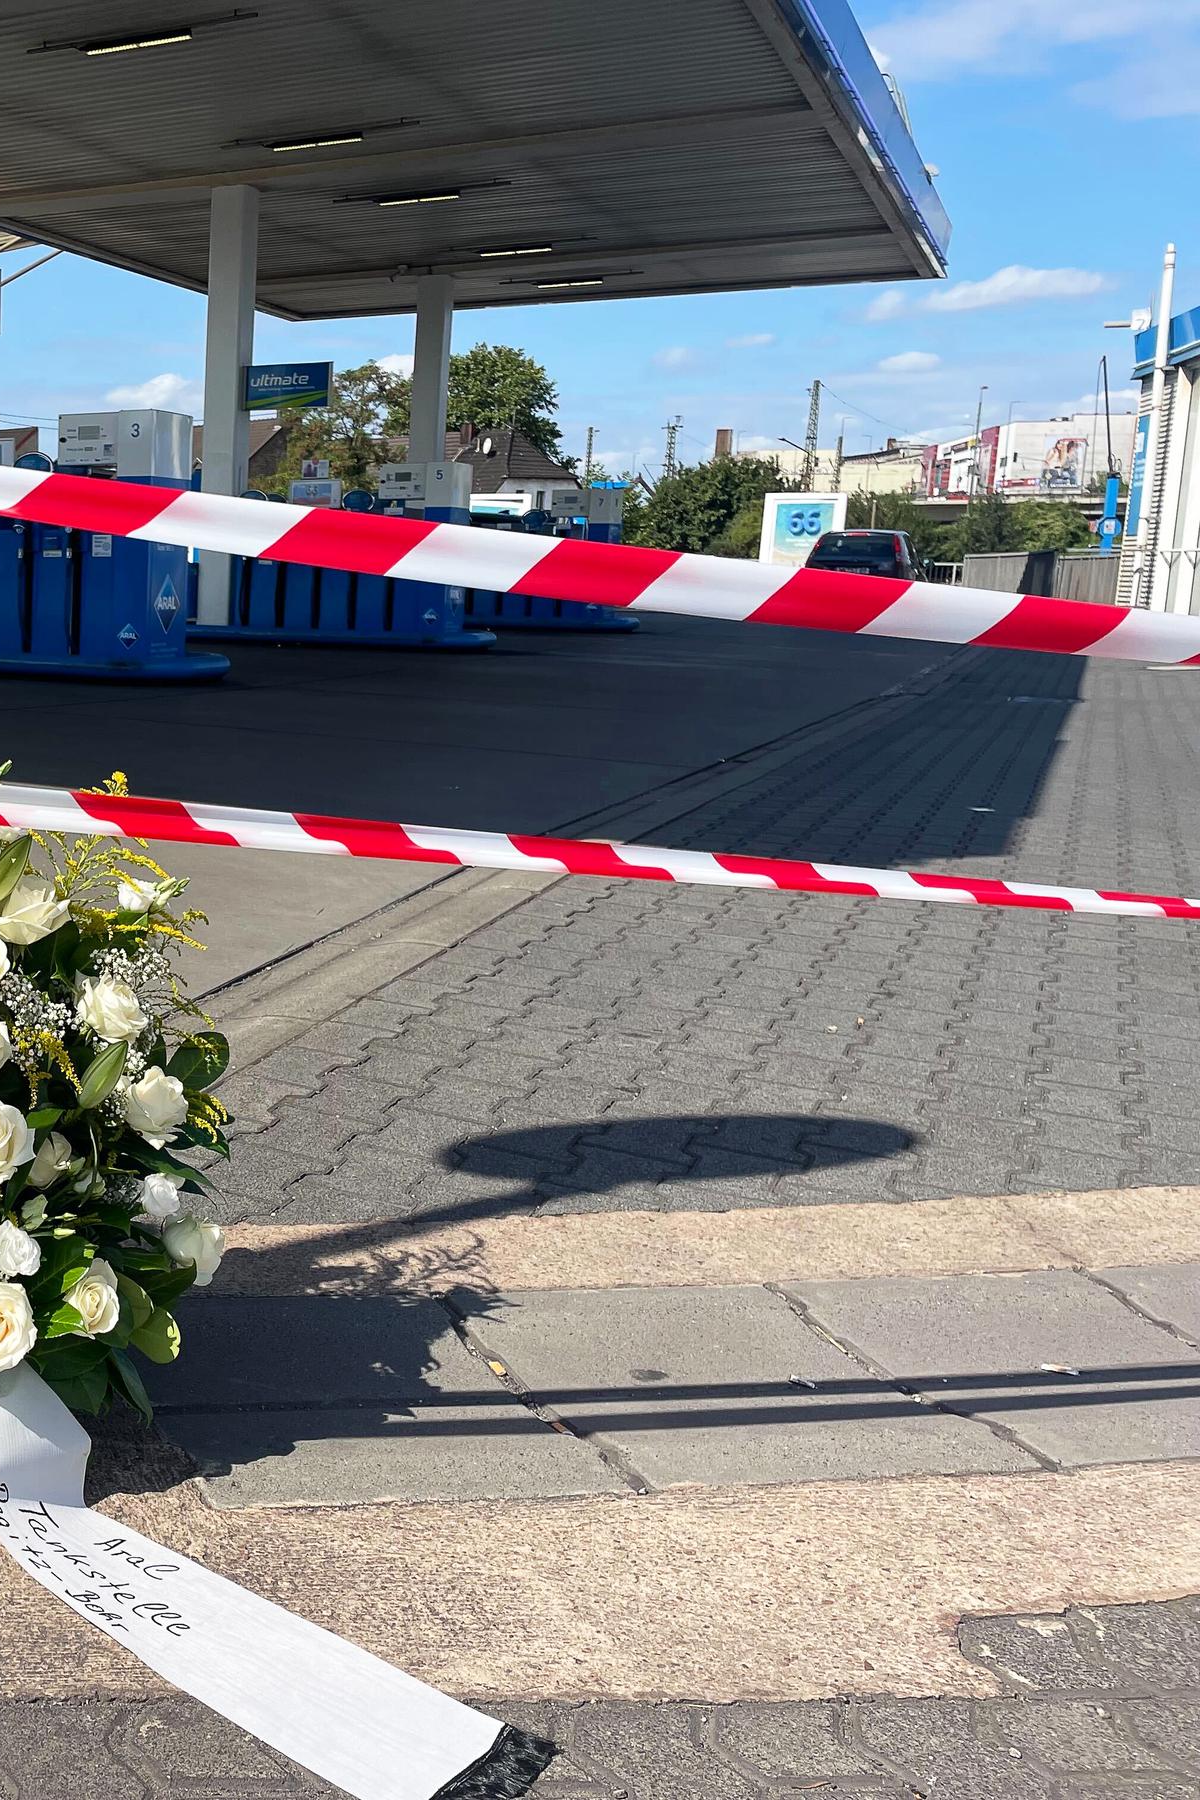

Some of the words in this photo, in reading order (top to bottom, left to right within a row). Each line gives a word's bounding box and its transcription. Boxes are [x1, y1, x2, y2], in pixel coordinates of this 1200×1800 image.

[250, 372, 309, 387] ultimate
[131, 423, 140, 438] 3
[436, 469, 444, 480] 5
[156, 595, 177, 610] ARAL
[119, 632, 137, 640] ARAL
[93, 1538, 181, 1580] Aral
[18, 1500, 191, 1637] Tankstelle
